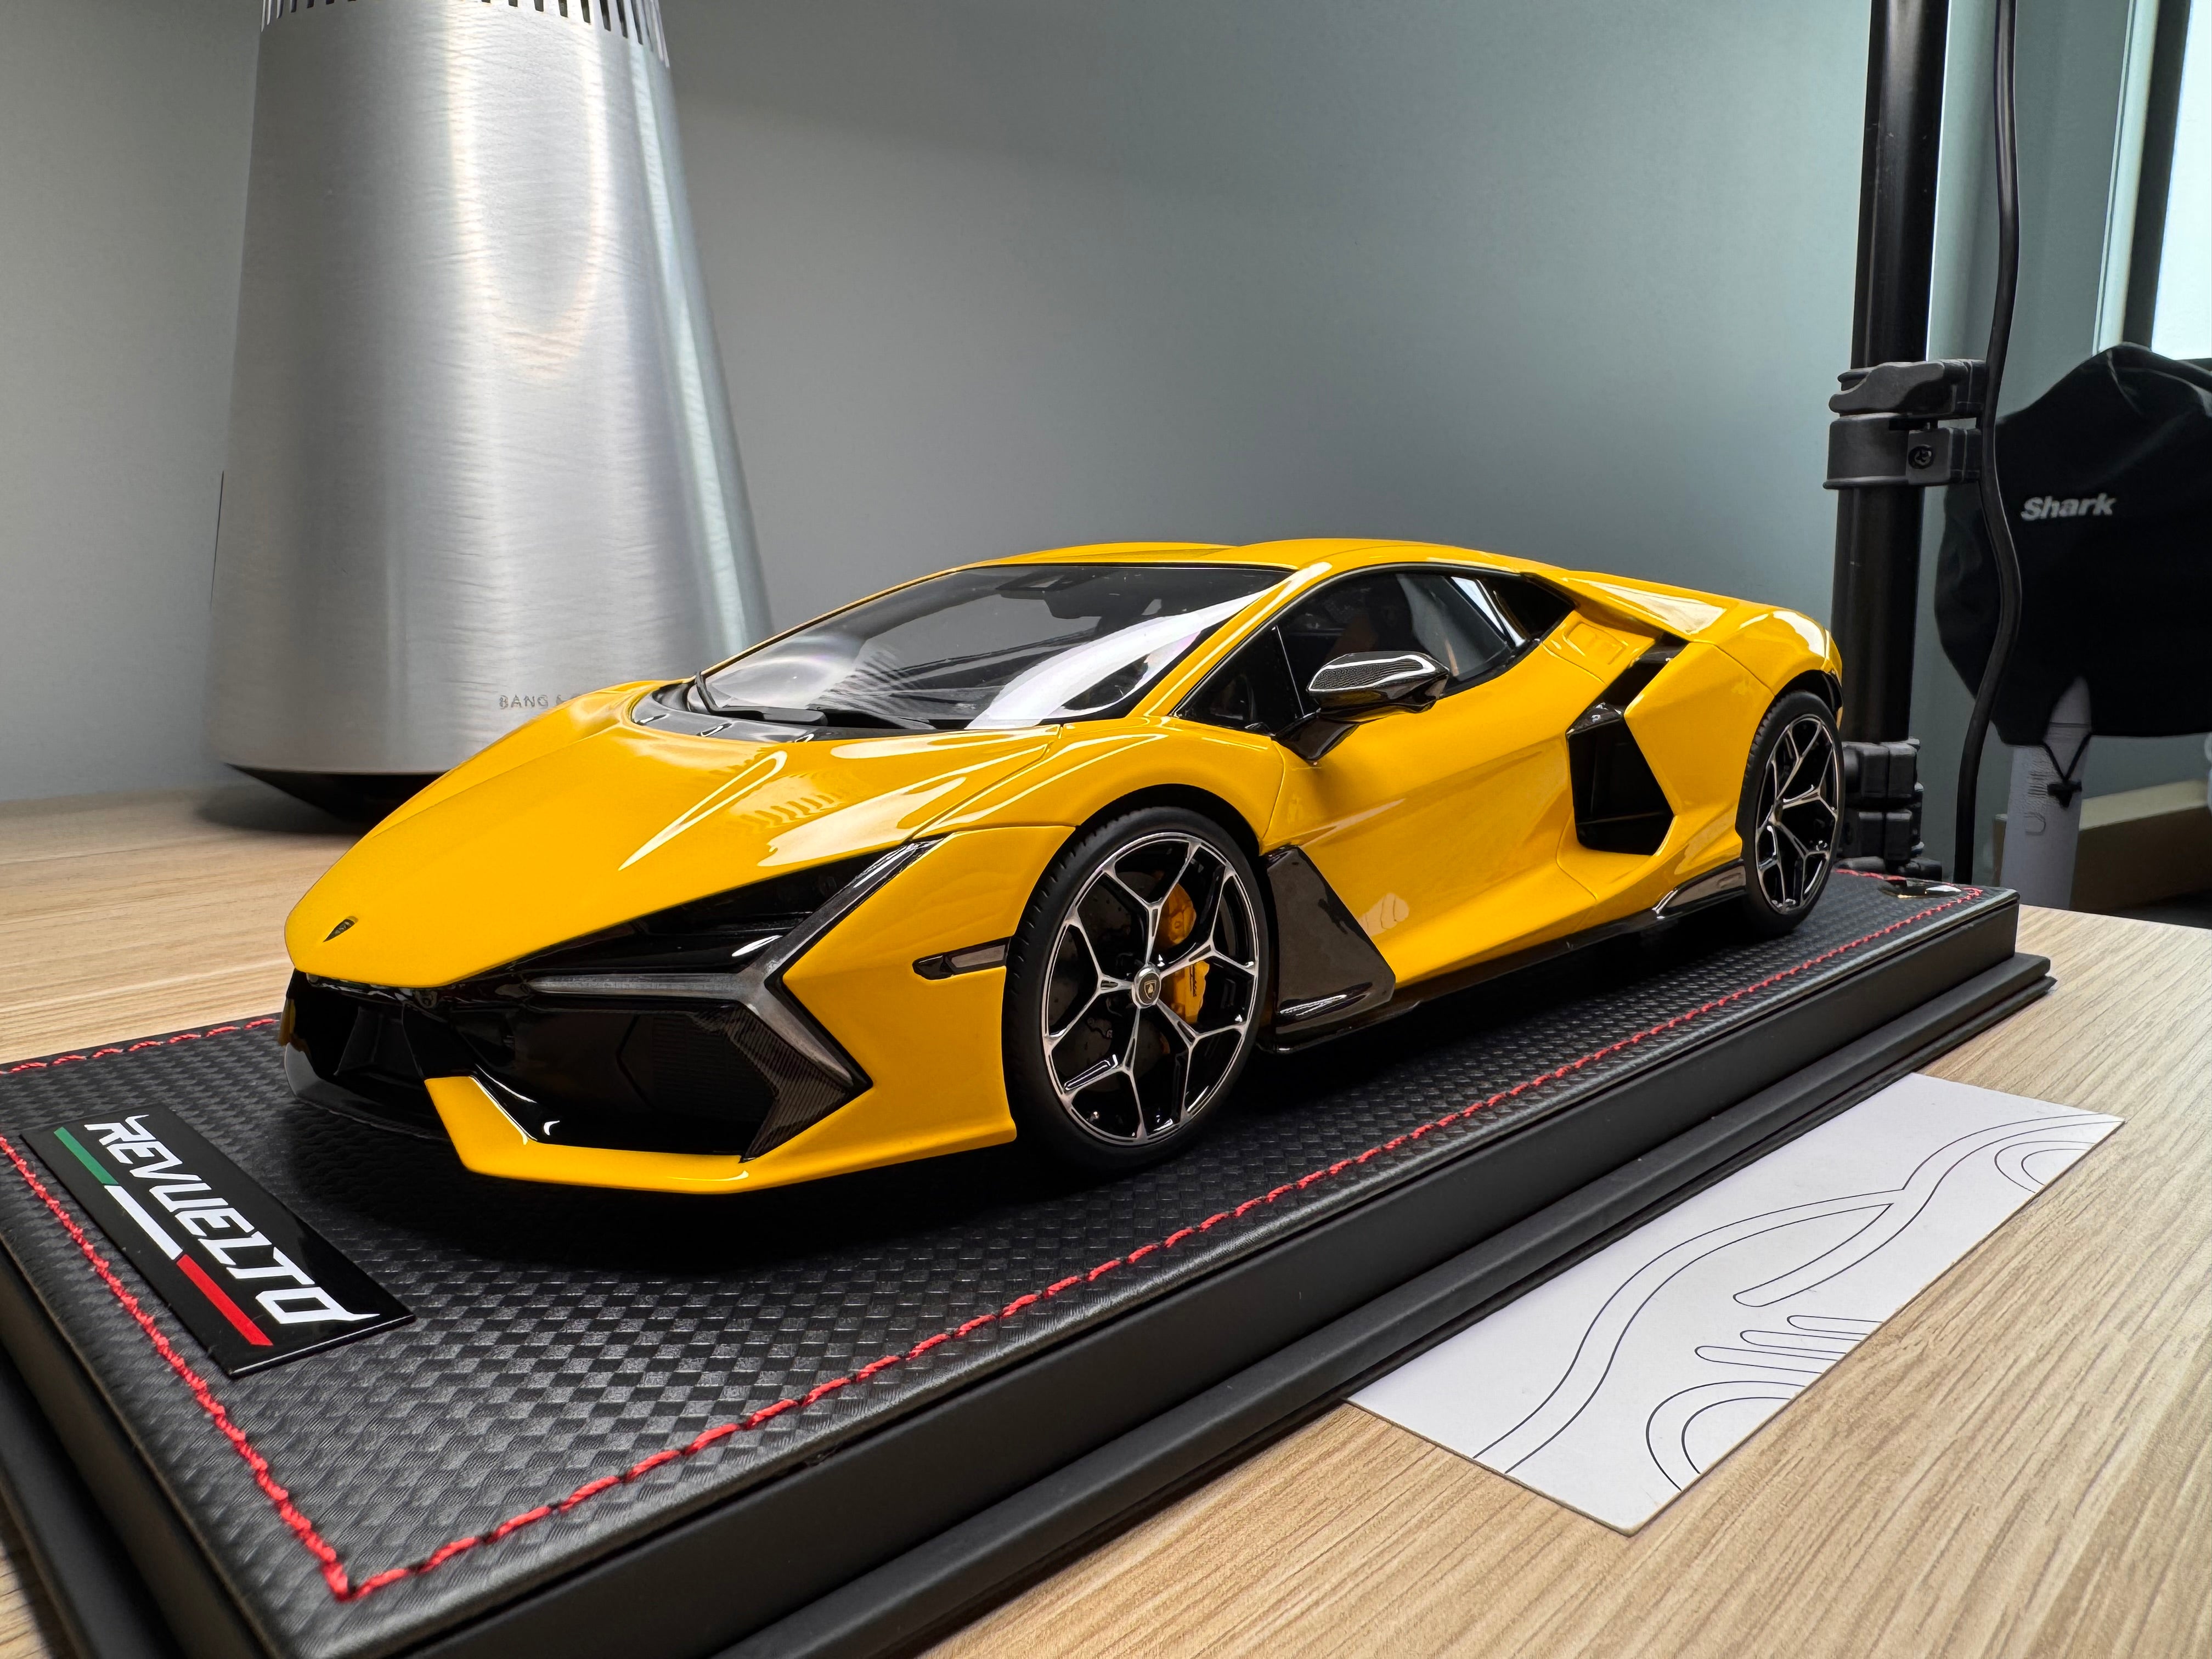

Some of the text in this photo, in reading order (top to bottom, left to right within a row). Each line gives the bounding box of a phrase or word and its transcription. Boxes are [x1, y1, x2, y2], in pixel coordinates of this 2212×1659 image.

[2021, 493, 2117, 521] Shark
[499, 695, 549, 709] BANG
[84, 1114, 380, 1324] REVUELTO
